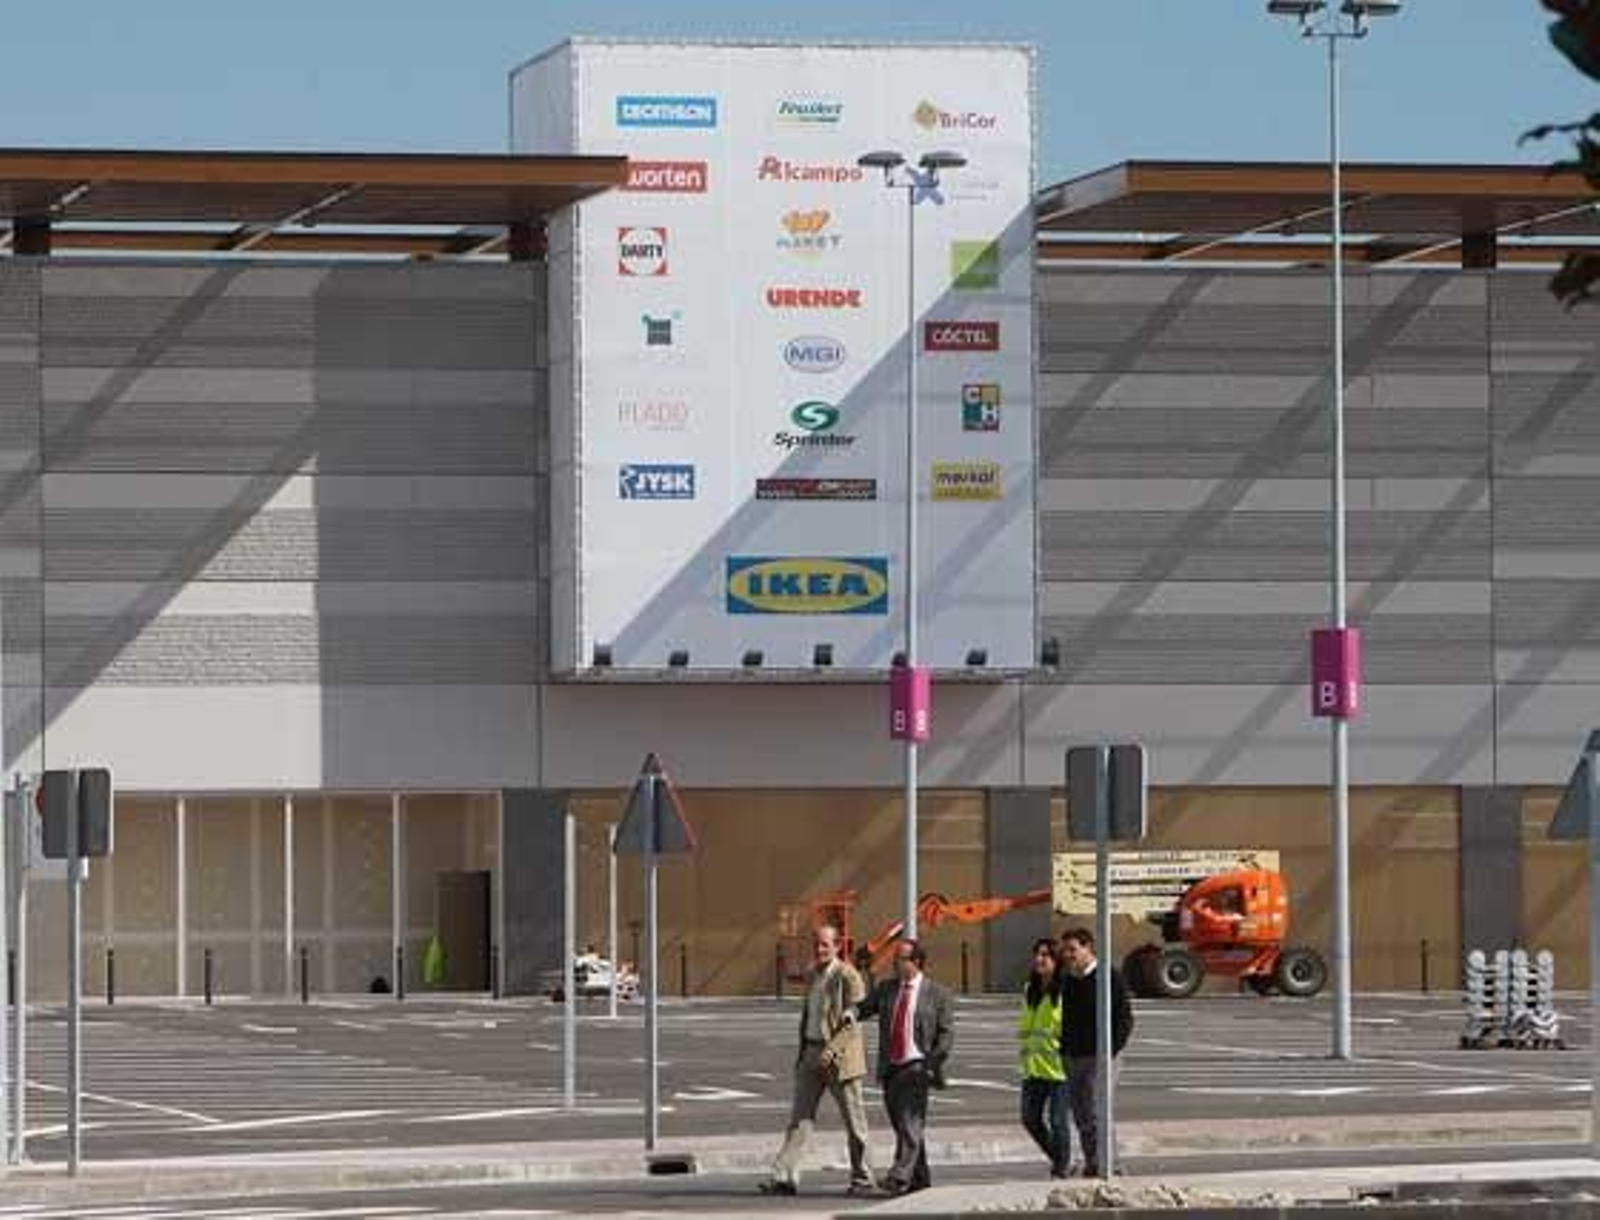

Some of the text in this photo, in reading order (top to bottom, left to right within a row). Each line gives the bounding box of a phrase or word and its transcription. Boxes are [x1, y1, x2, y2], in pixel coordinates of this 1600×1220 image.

[758, 155, 863, 183] Alcampo
[767, 289, 862, 308] URENDE
[635, 472, 691, 492] JYSK
[748, 573, 869, 596] IKEA
[1321, 681, 1337, 708] B
